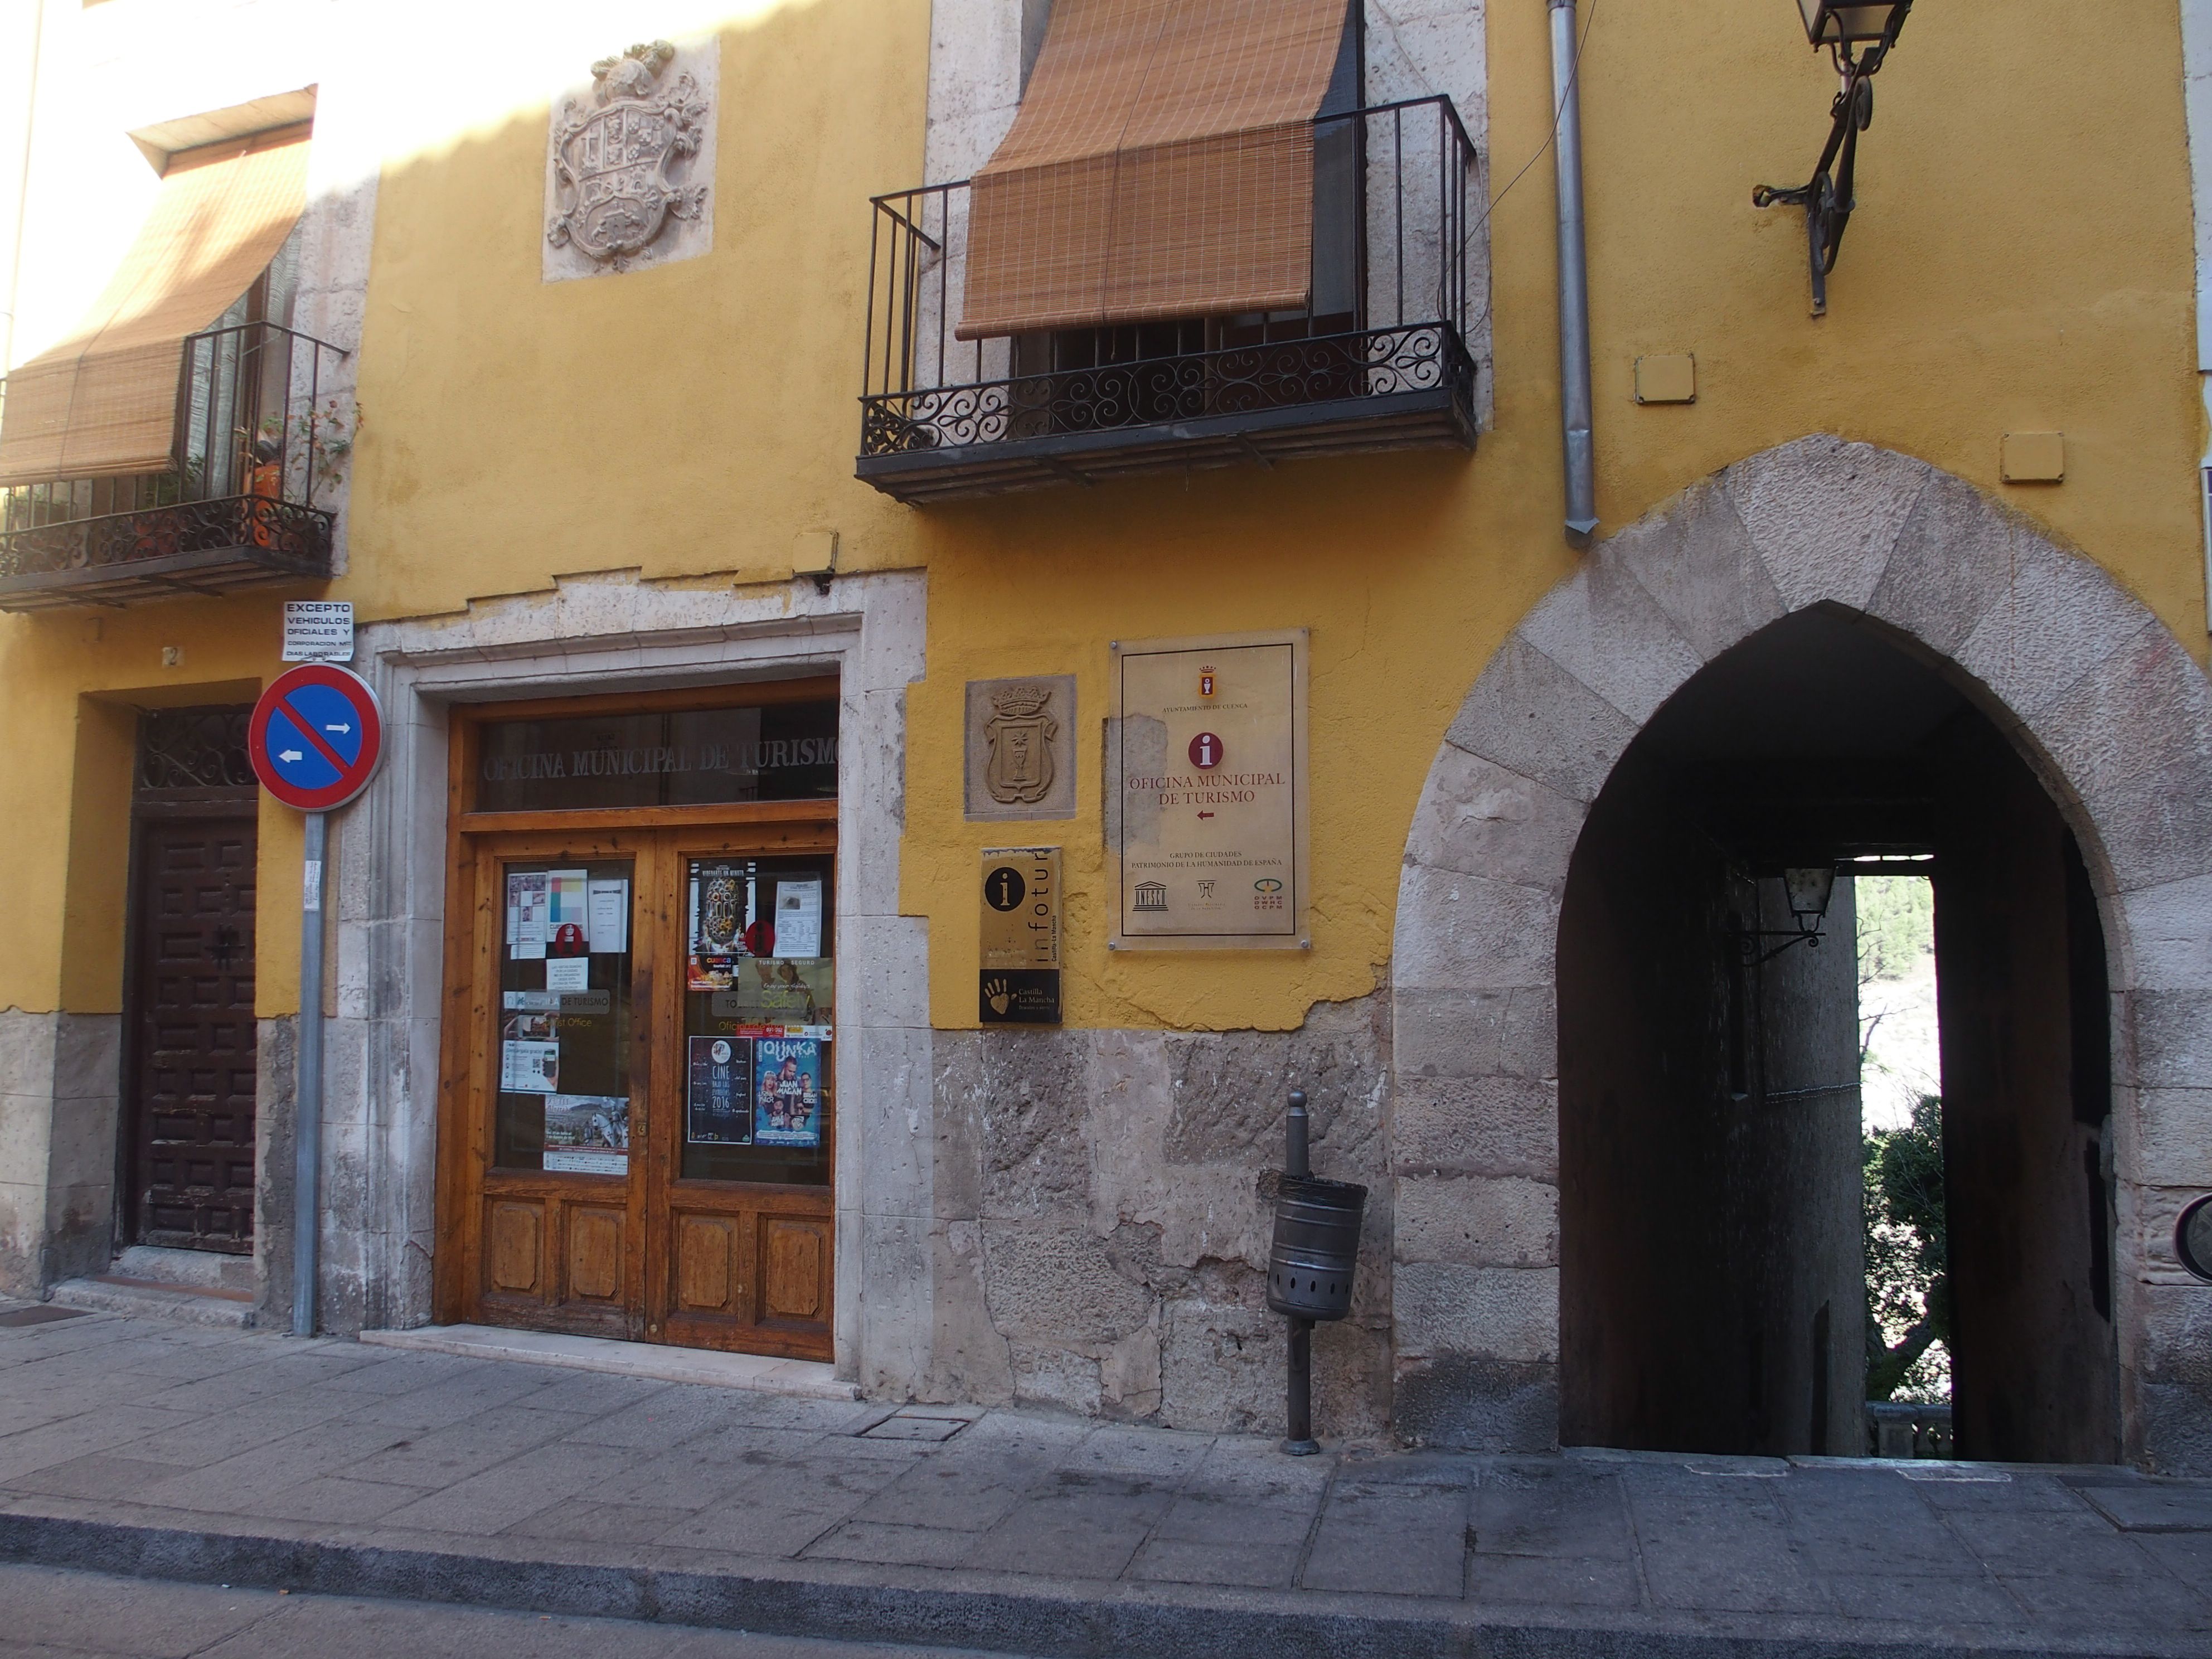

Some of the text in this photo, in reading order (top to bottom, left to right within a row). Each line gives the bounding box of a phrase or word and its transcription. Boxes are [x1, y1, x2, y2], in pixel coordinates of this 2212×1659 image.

[287, 604, 350, 612] EXCEPTO
[484, 737, 838, 781] OFICINA MUNICIPAL DE TURISM
[1130, 773, 1285, 789] OFICINA MUNICIPAL
[1159, 790, 1255, 805] DE TURISMO
[1254, 857, 1282, 866] ESPAÑA
[1136, 890, 1165, 905] UNESCO
[1028, 853, 1049, 962] infotur
[561, 997, 571, 1006] DE
[574, 997, 608, 1006] TURISMO
[761, 990, 810, 1012] Safety
[567, 1018, 591, 1027] Office
[712, 1065, 730, 1079] CINE
[712, 1096, 730, 1108] 2016
